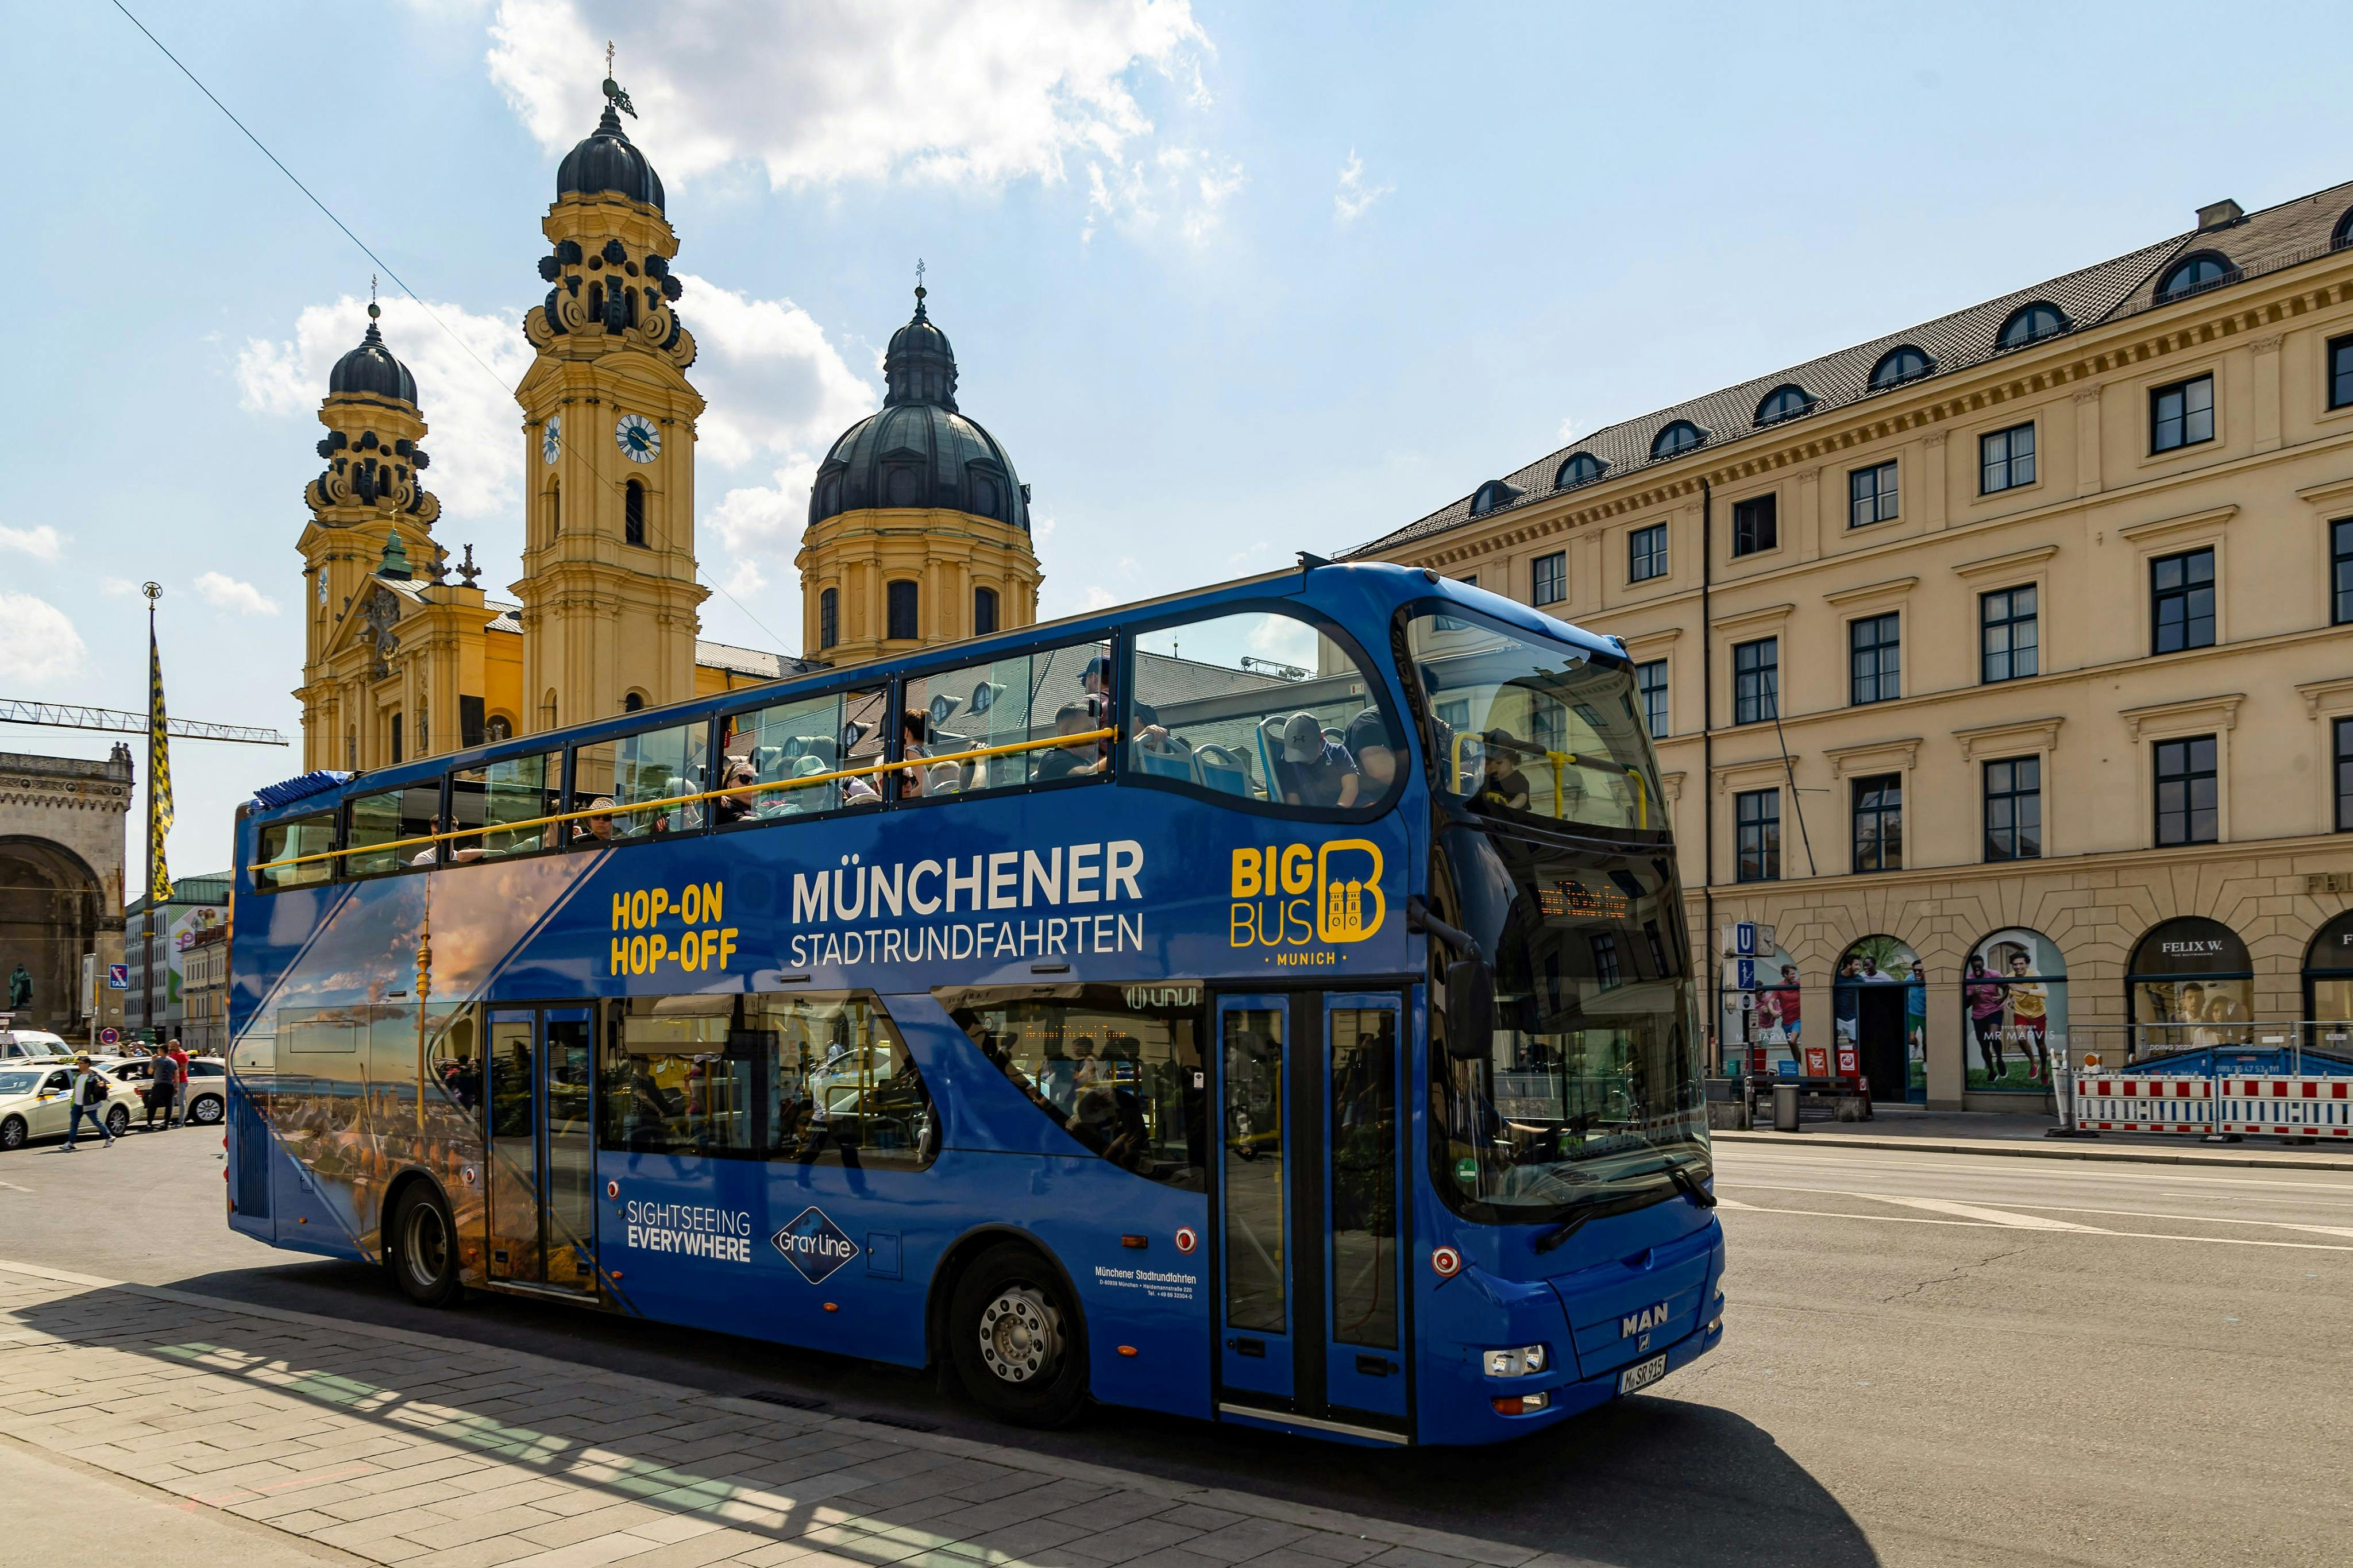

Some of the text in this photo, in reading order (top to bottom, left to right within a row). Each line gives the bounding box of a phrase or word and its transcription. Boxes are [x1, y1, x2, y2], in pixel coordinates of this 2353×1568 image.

[792, 840, 1144, 924] MÜNCHENER
[1231, 844, 1313, 898] BIG
[612, 882, 723, 930] HOP-ON
[1230, 899, 1313, 947] BUS
[611, 928, 738, 975] HOP-OFF
[790, 913, 1143, 967] STADTRUNDFAHRTEN
[1741, 928, 1750, 949] U
[2162, 941, 2223, 952] FELIX W.
[1277, 952, 1335, 965] MUNICH
[1984, 1030, 2055, 1040] MR MARVIS
[627, 1200, 750, 1236] SIGHTSEEING
[628, 1225, 750, 1263] EVERYWHERE
[1095, 1266, 1197, 1284] Münchener Stadtrundfahrten
[1622, 1303, 1668, 1339] MAN
